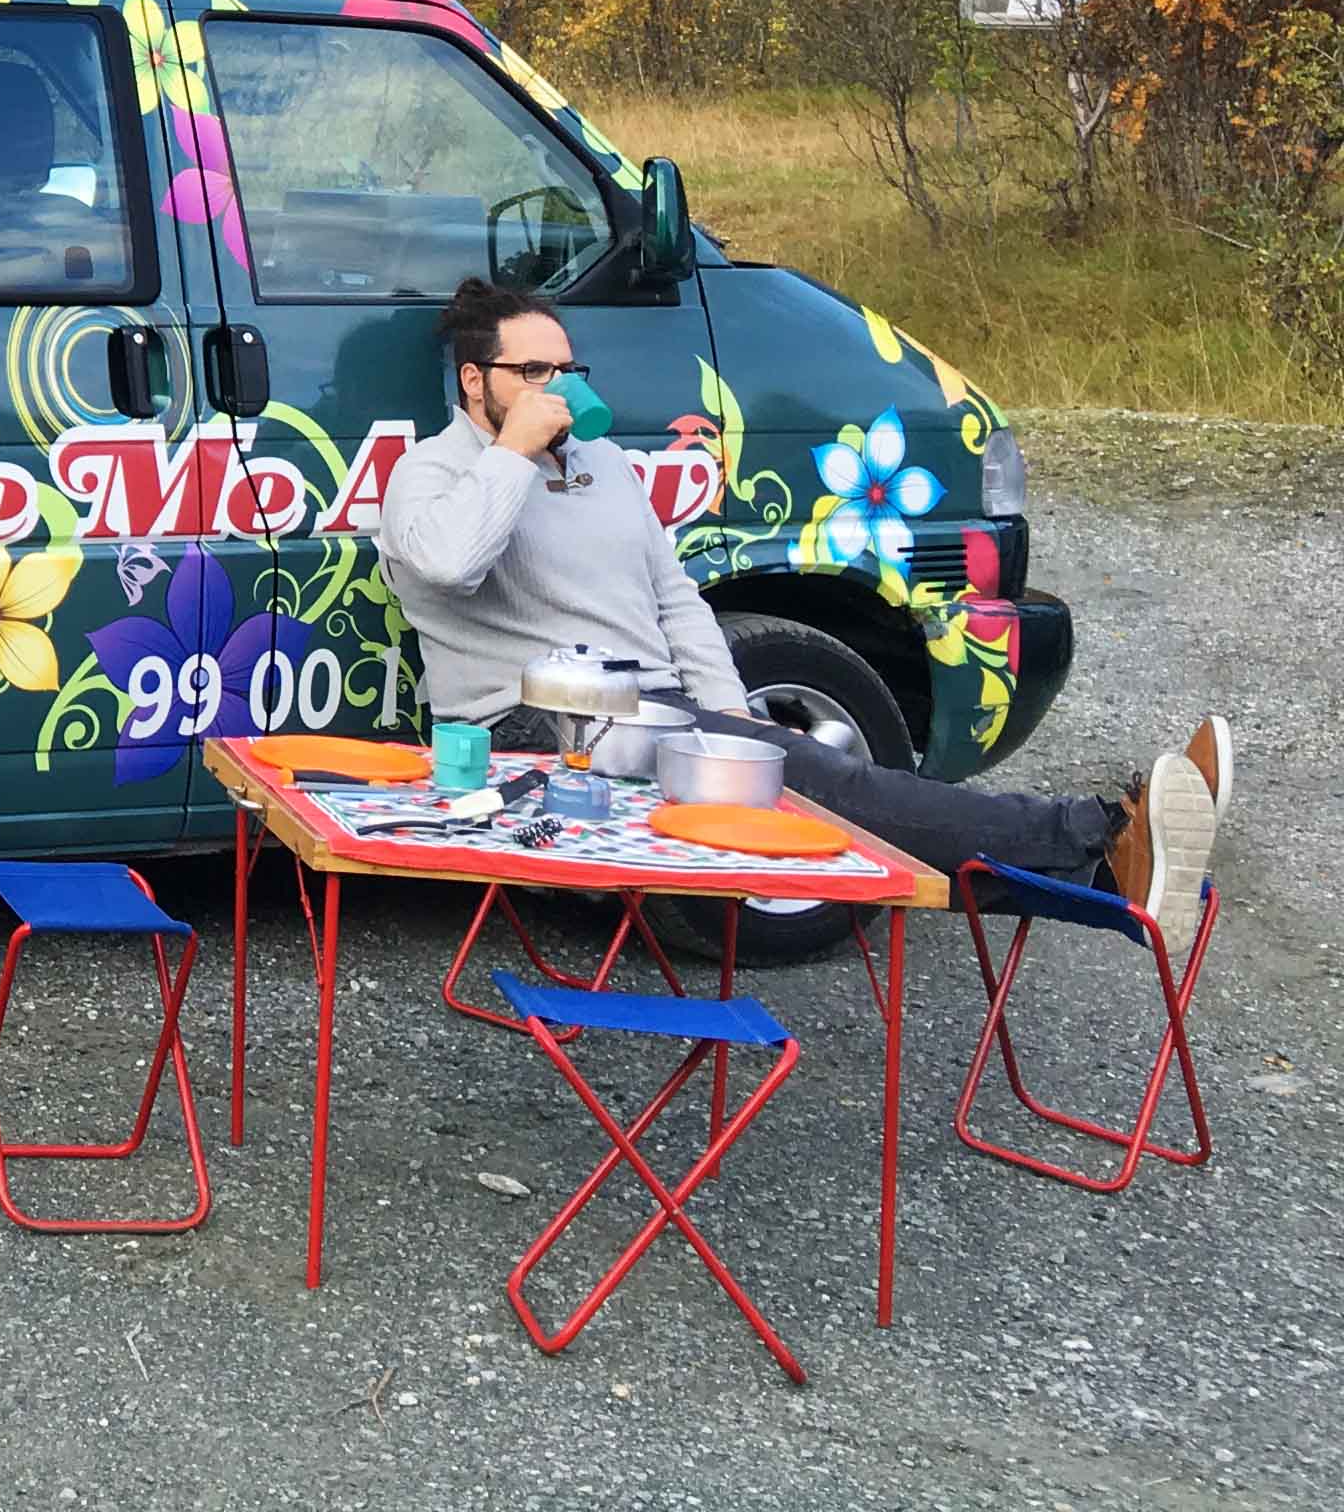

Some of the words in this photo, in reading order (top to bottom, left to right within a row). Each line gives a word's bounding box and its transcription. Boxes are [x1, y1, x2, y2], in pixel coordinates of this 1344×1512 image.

[49, 422, 306, 544] Me
[128, 653, 223, 739] 99
[249, 648, 342, 731] 00
